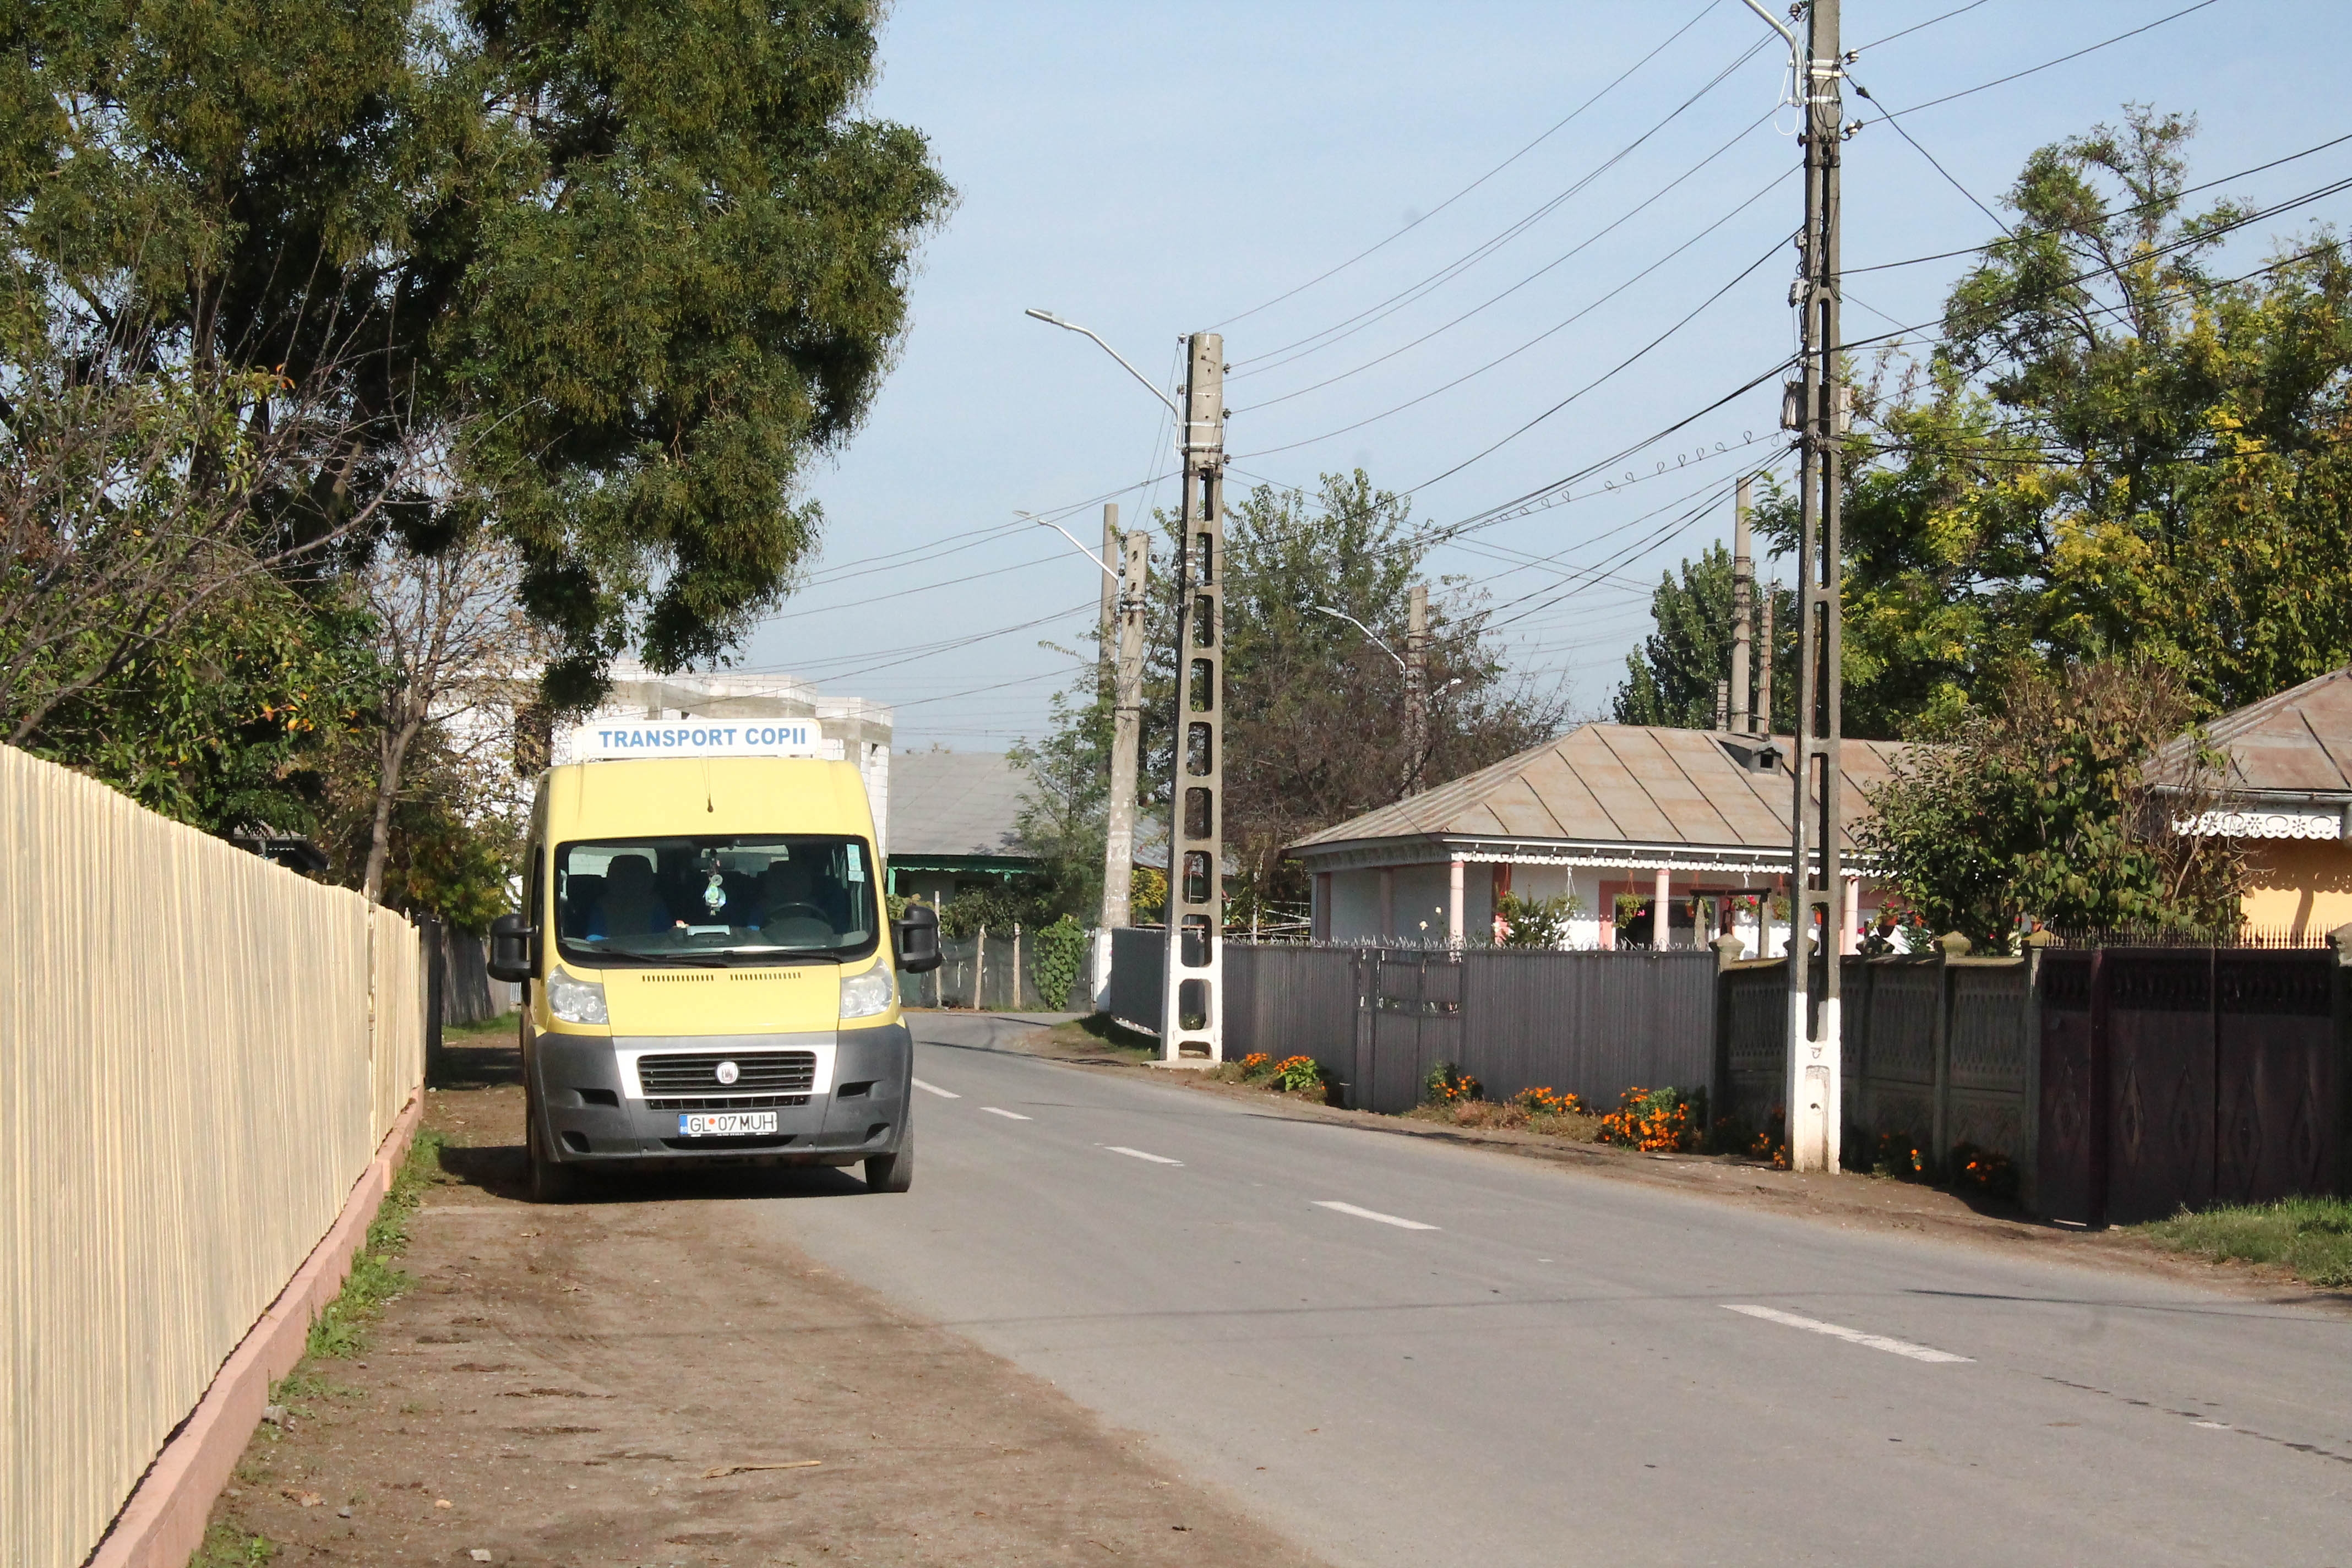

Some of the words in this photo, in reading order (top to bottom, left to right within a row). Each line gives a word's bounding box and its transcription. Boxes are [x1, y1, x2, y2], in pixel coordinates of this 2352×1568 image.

[598, 728, 737, 748] TRANSPORT
[745, 727, 806, 745] COPII
[690, 1117, 711, 1133] GL
[718, 1116, 737, 1131] 07
[739, 1114, 774, 1130] MUH
